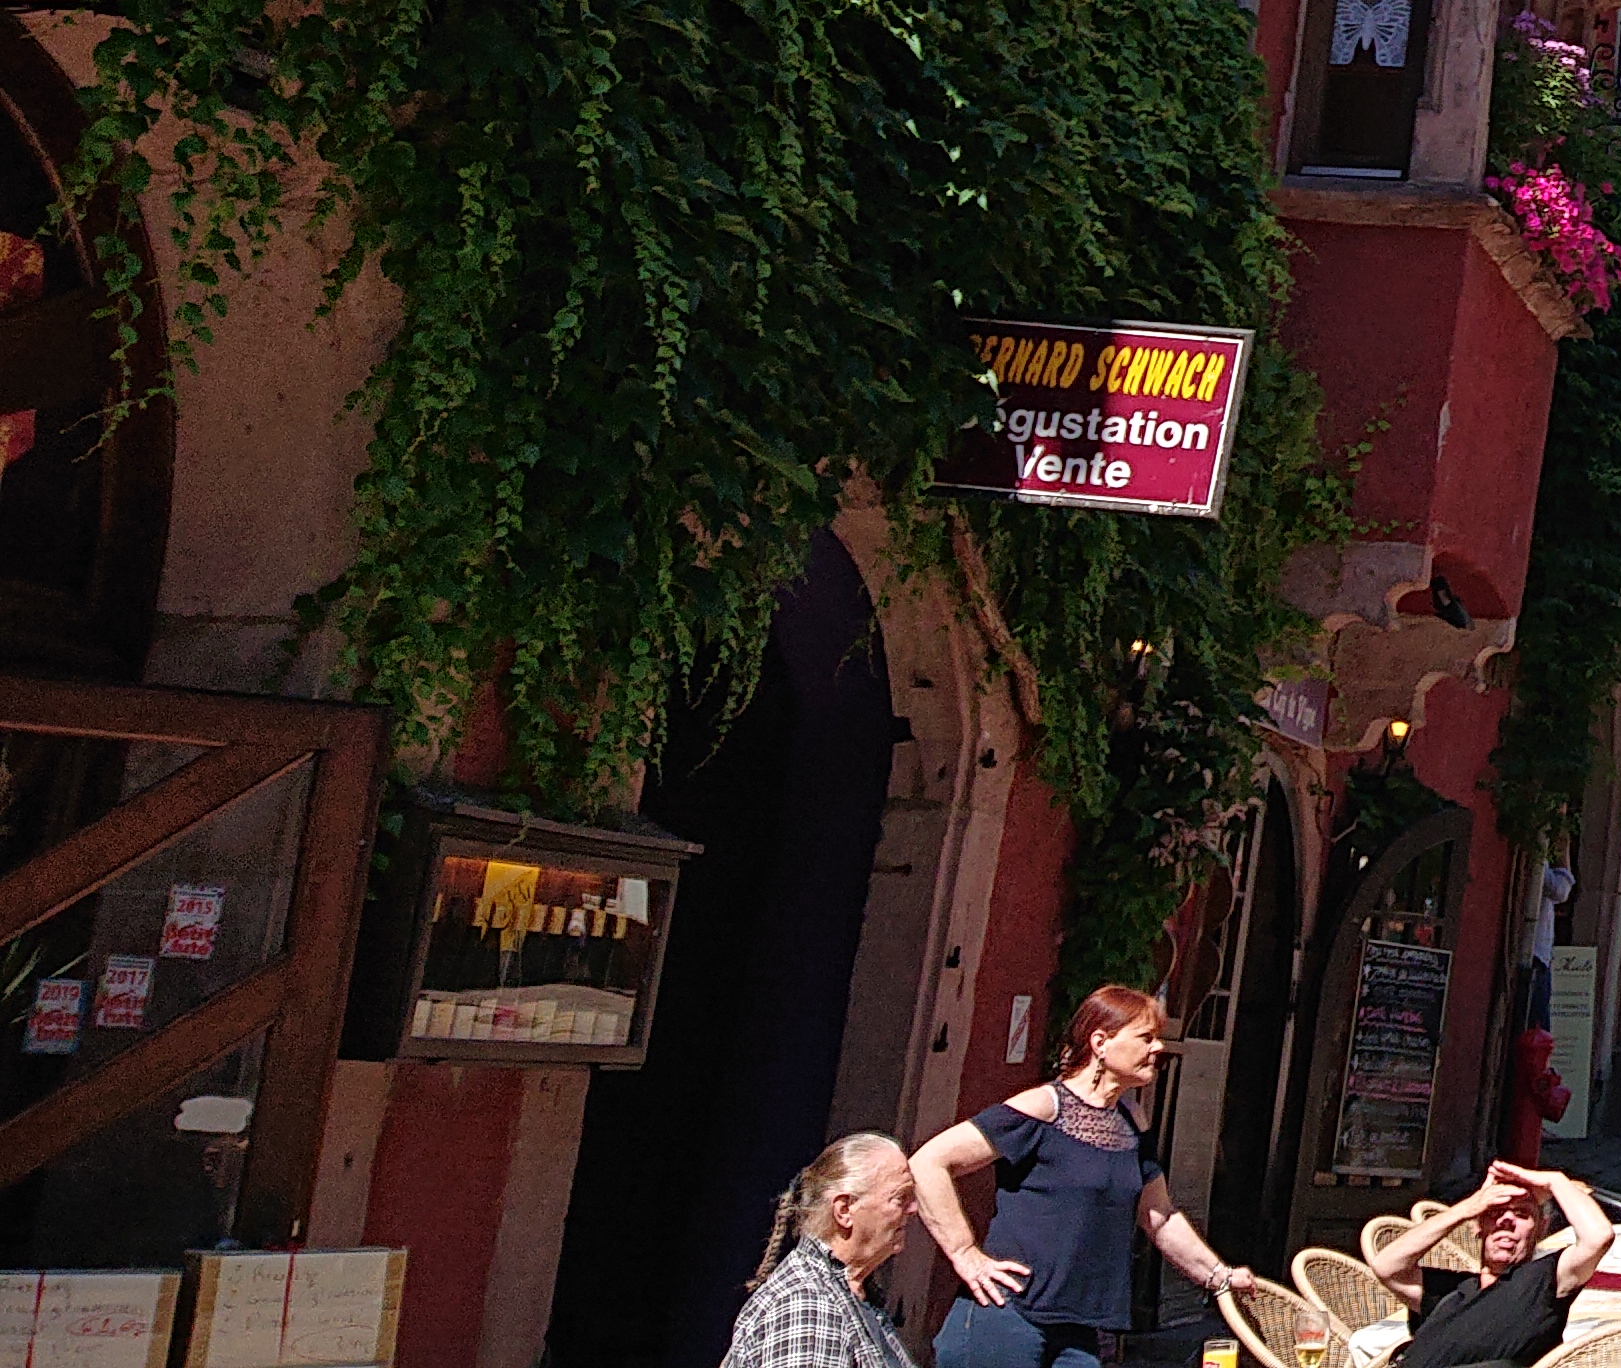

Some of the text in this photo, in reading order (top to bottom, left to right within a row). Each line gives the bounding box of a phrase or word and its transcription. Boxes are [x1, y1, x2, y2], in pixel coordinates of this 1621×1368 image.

[1089, 344, 1226, 403] SCHWACH
[997, 400, 1209, 450] gustation
[1014, 443, 1132, 489] Vente
[176, 896, 214, 914] 2015
[105, 968, 150, 986] 2017
